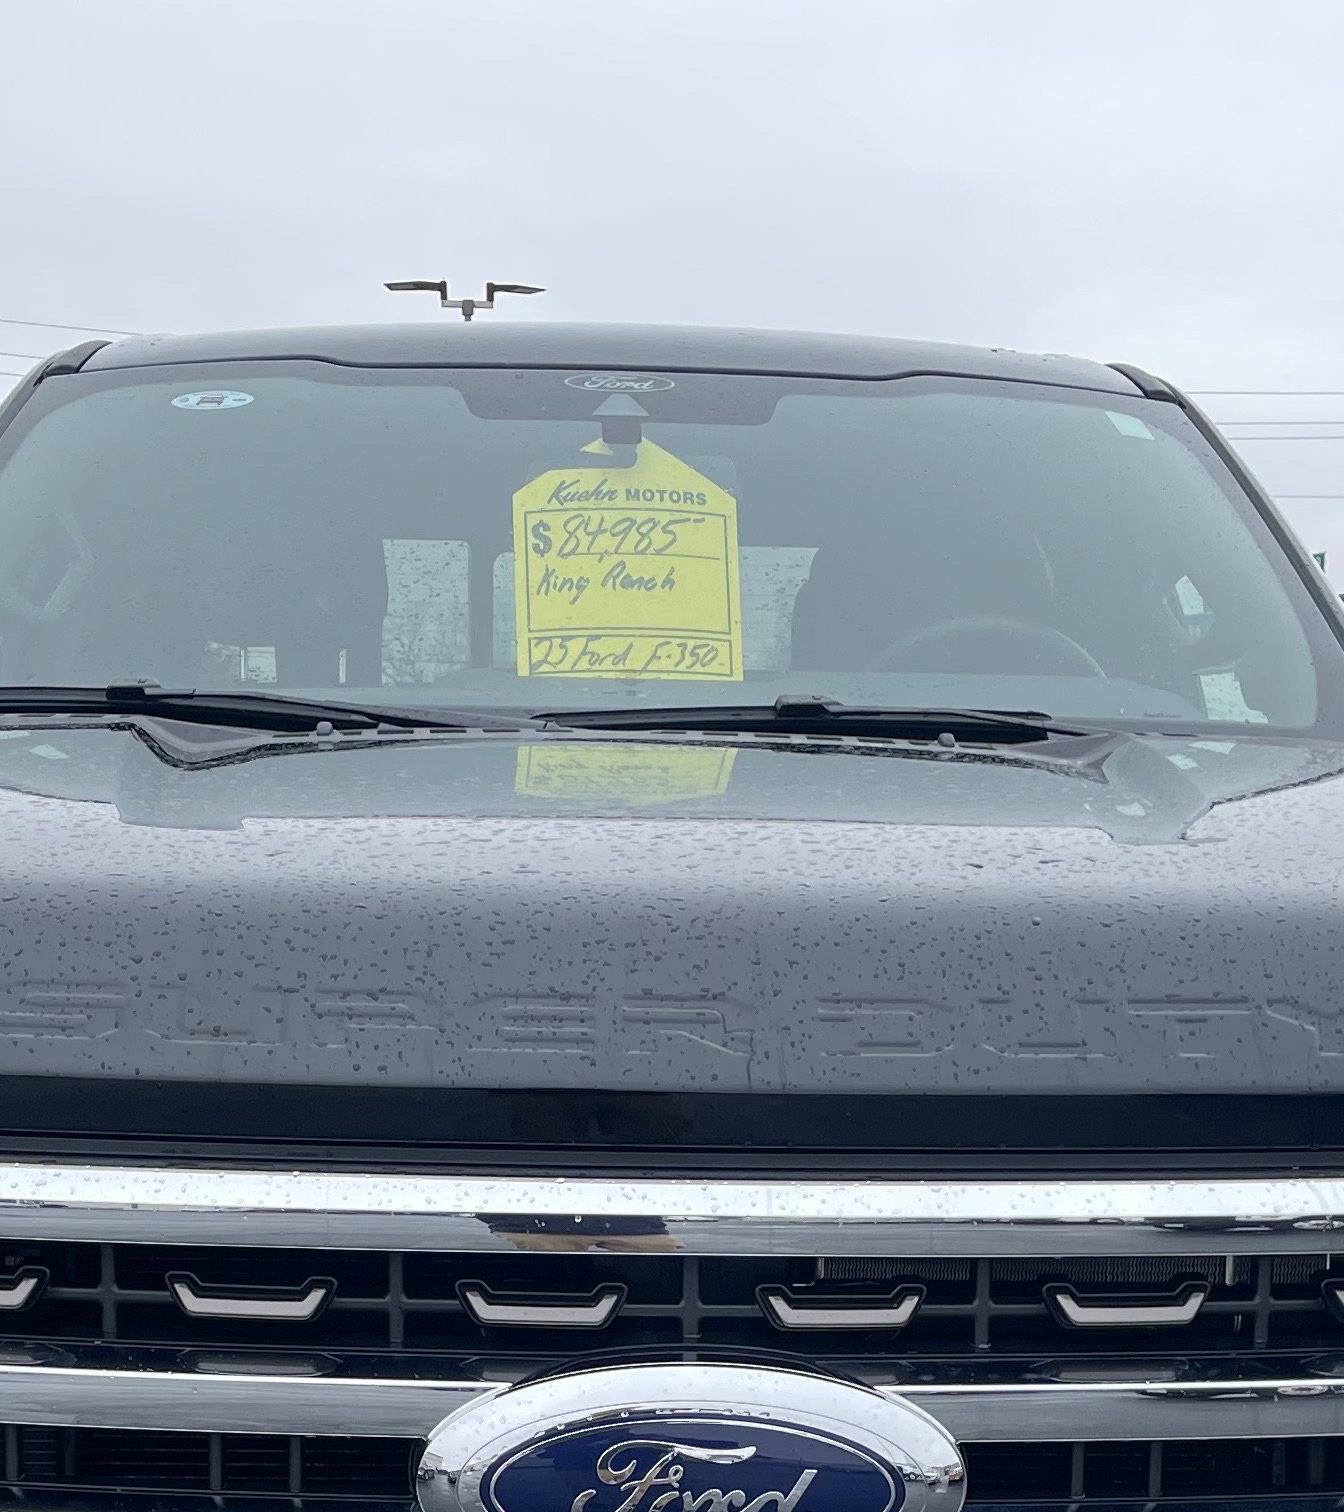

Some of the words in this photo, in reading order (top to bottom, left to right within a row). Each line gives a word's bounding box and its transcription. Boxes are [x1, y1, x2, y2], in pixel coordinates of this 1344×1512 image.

[584, 376, 654, 389] Ford
[547, 479, 617, 506] Kuehn
[625, 488, 707, 506] MOTORS
[536, 564, 590, 605] King
[530, 636, 576, 671] 25
[571, 635, 633, 670] Ford
